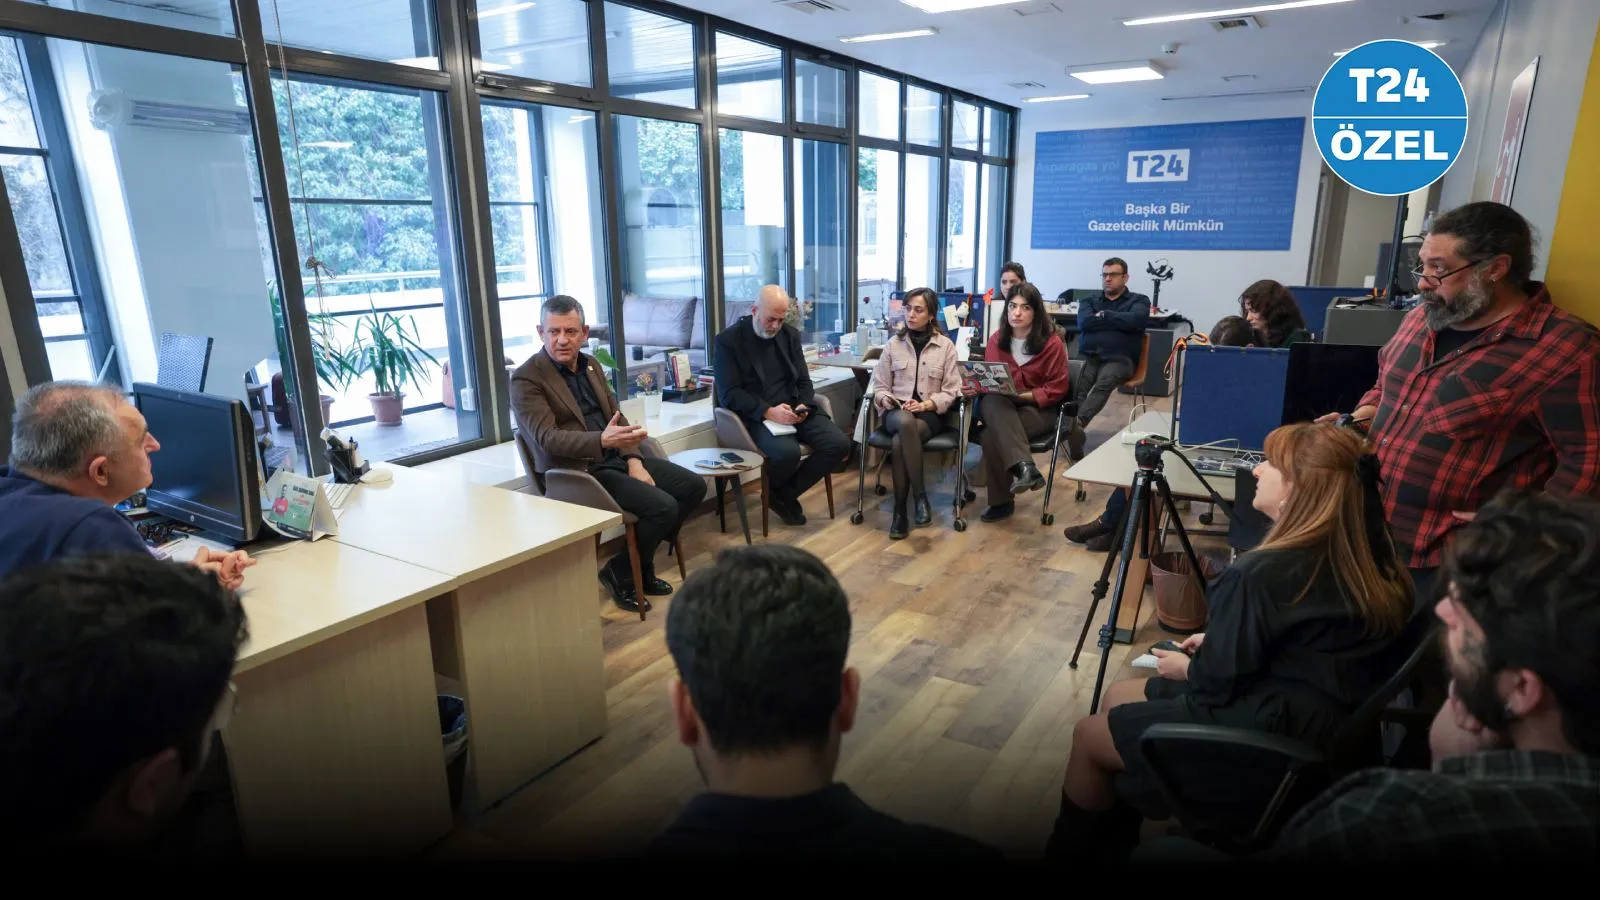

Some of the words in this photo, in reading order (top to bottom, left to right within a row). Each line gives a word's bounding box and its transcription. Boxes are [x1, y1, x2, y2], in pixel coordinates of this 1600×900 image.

[1132, 154, 1184, 178] T24
[1125, 203, 1166, 218] Başka
[1170, 202, 1190, 215] Bir
[1087, 219, 1160, 232] Gazetecilik
[1163, 218, 1224, 232] Mümkün
